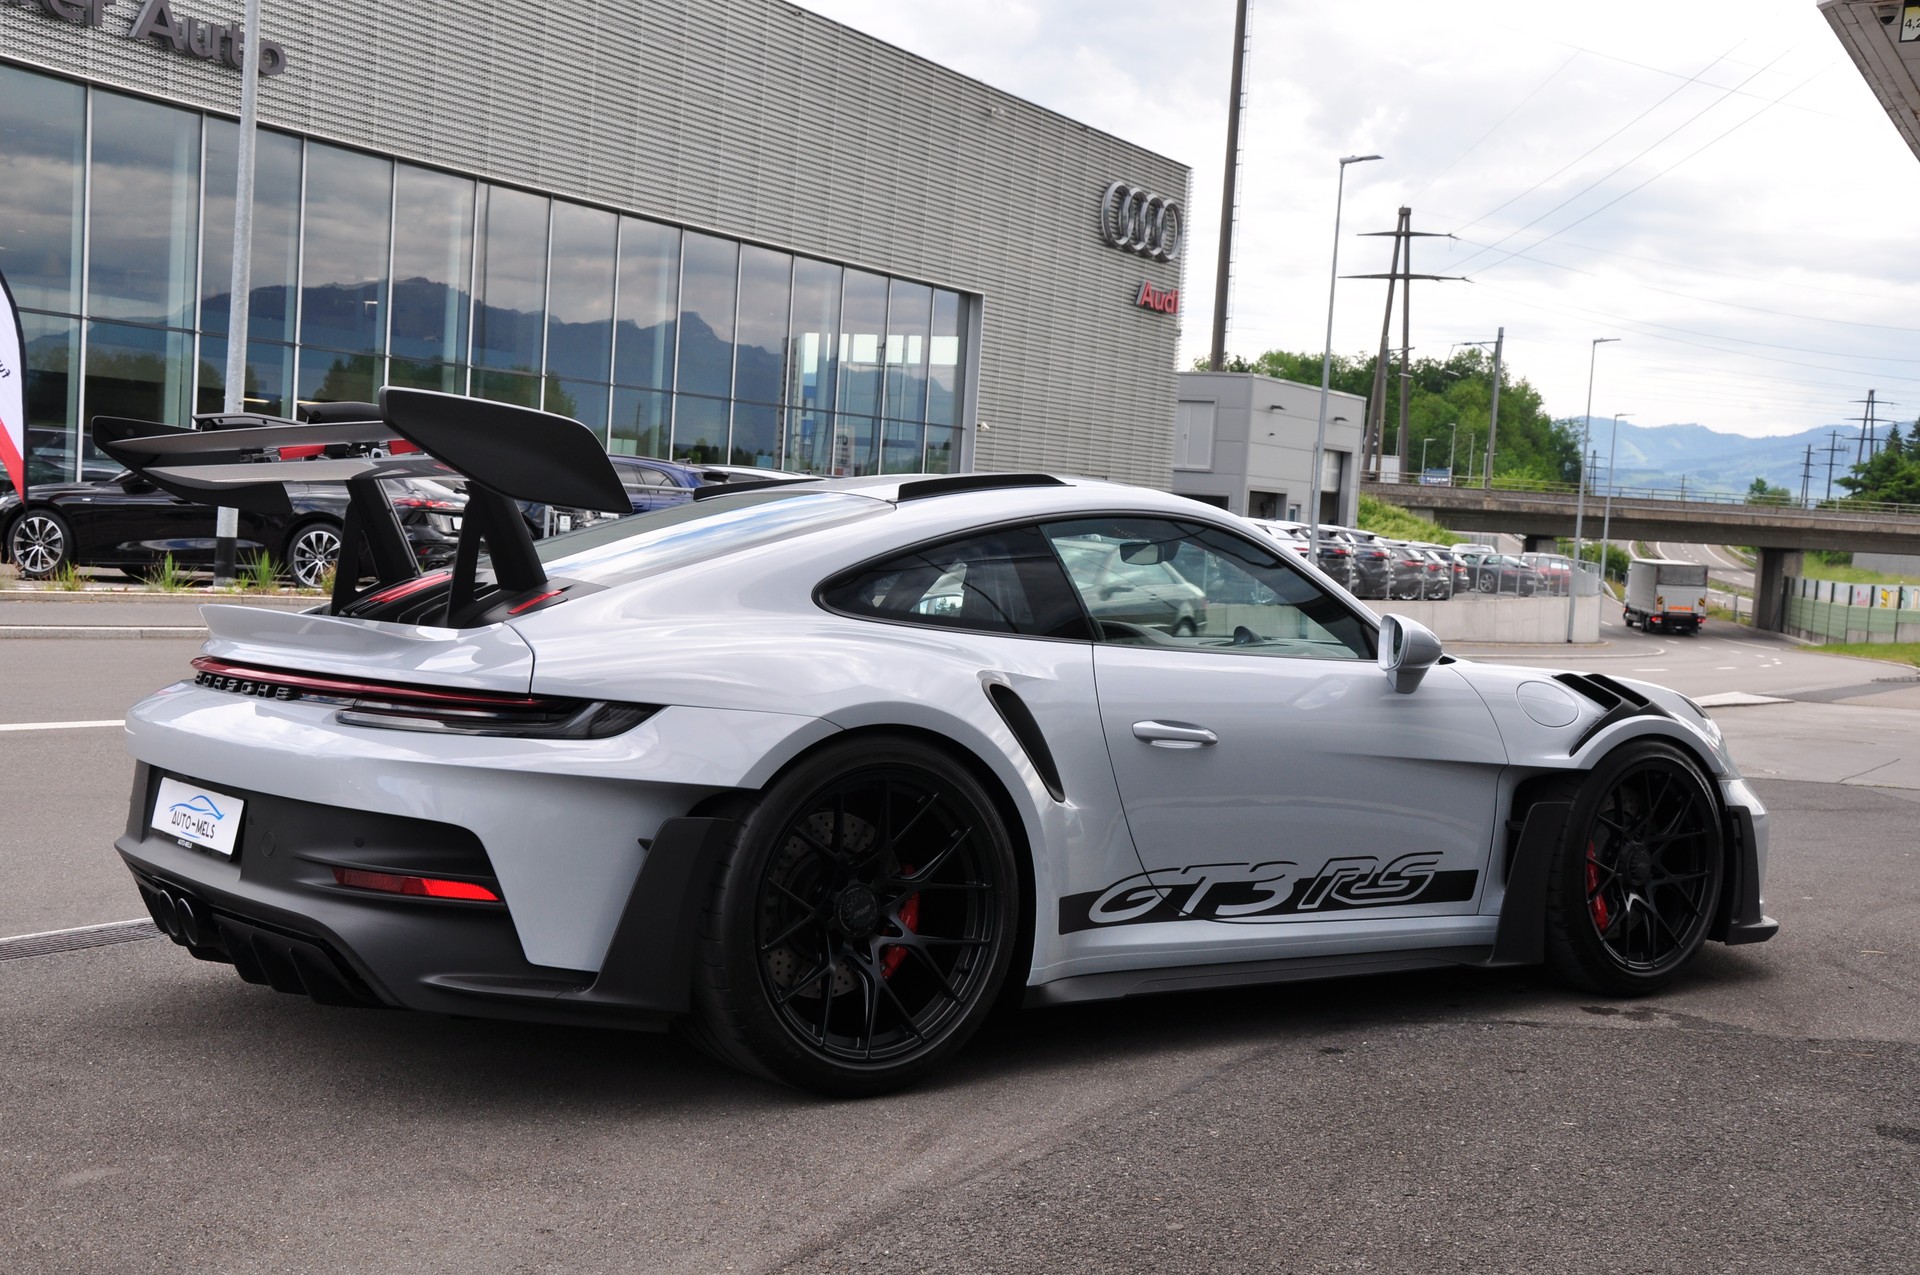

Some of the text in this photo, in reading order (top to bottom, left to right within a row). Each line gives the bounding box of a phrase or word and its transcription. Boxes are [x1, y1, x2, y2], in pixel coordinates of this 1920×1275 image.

[129, 0, 286, 76] Auto
[1137, 281, 1179, 314] Audi
[194, 672, 291, 700] PORSCHE
[171, 810, 215, 839] AUTO-MELS
